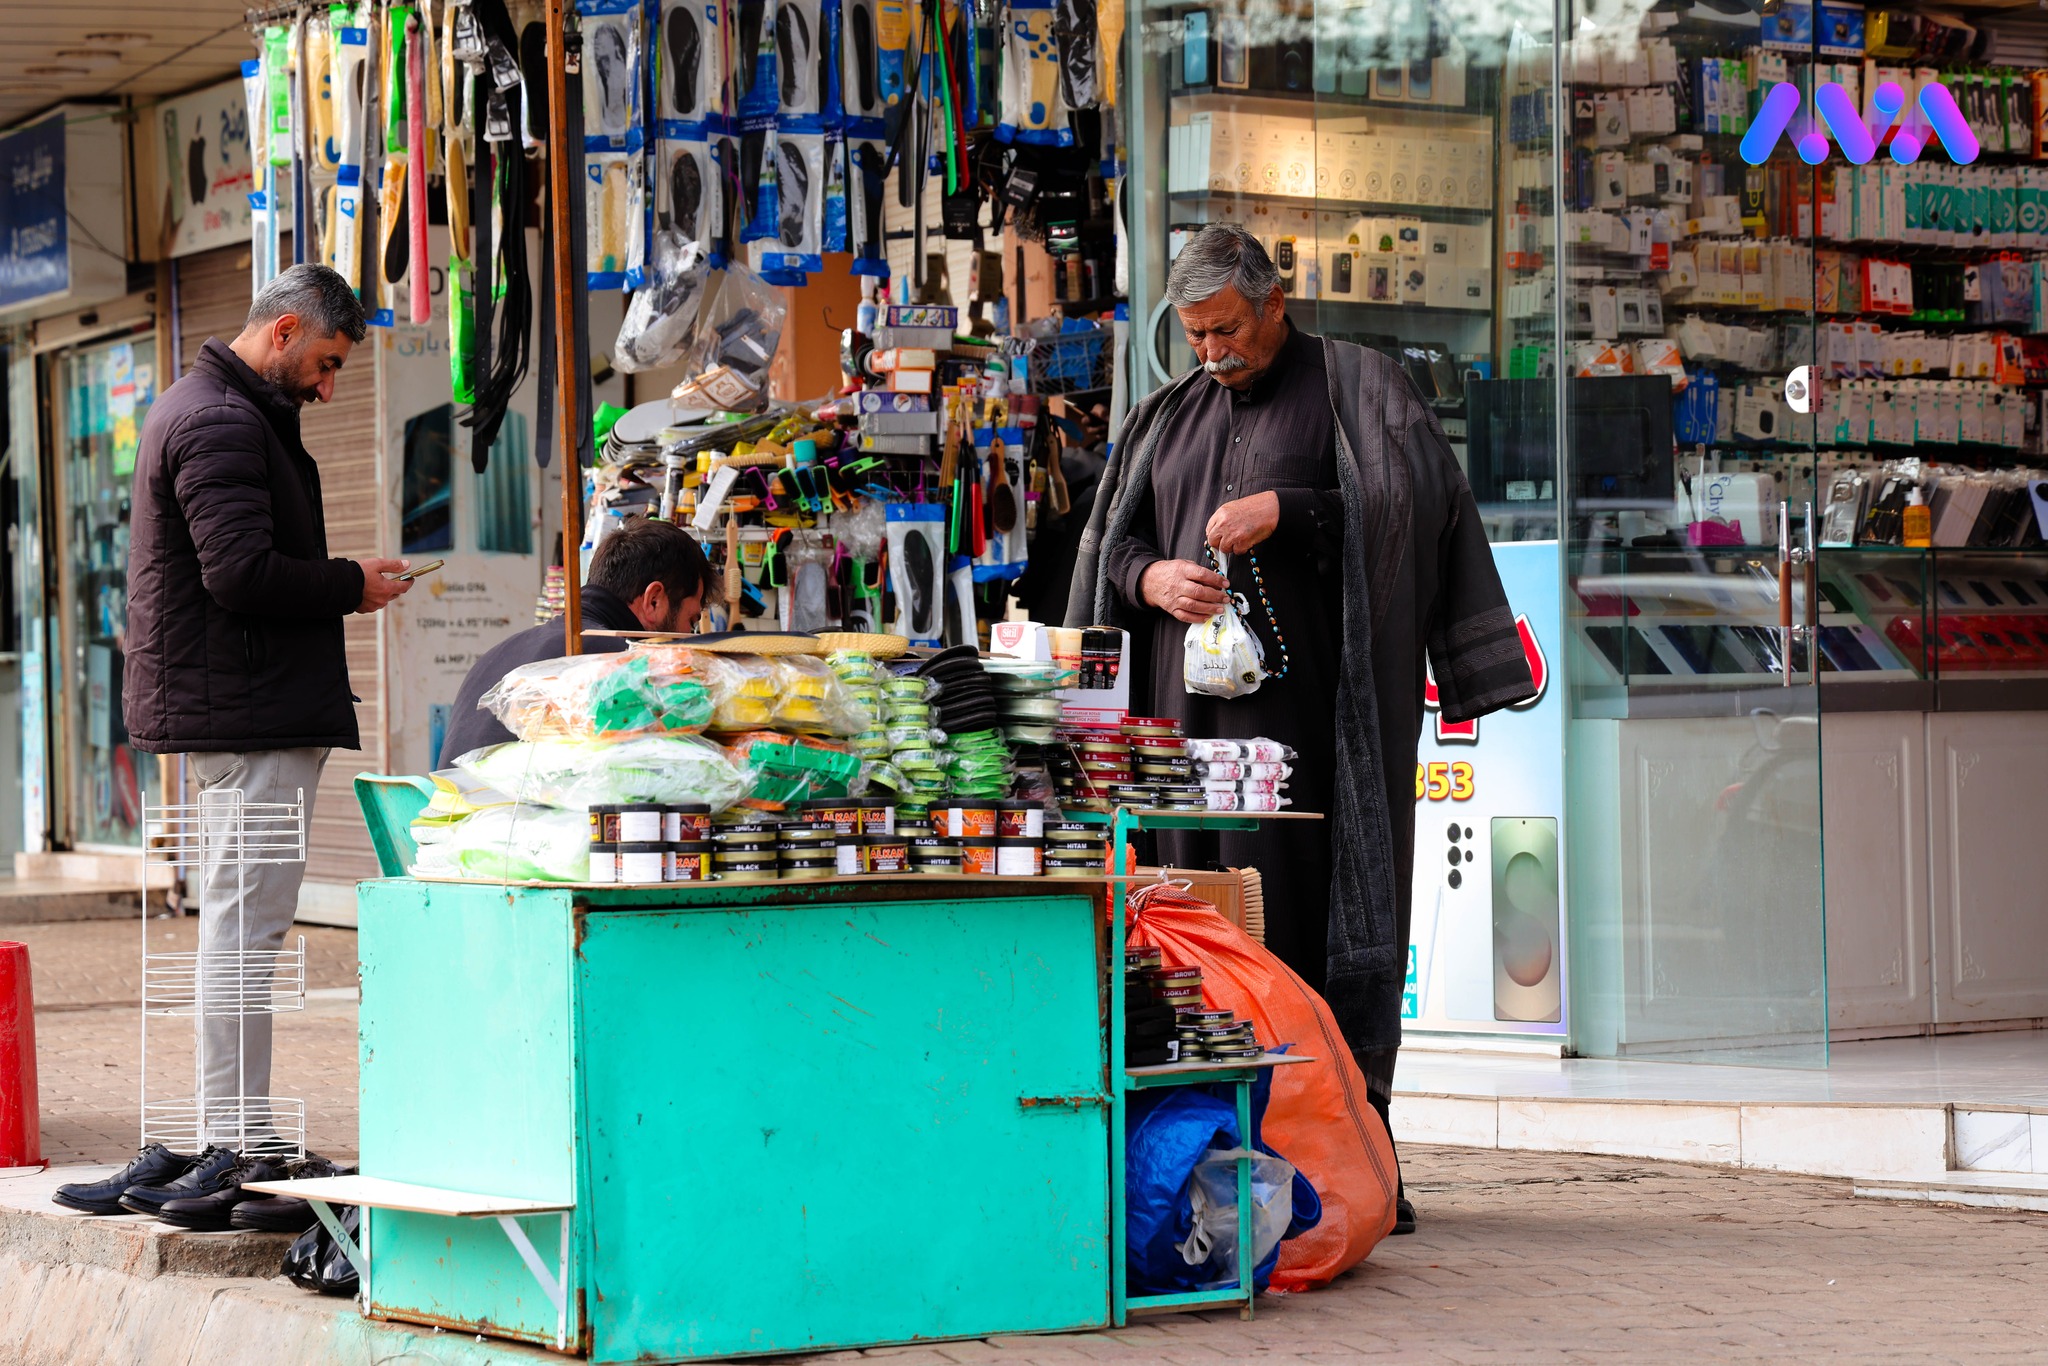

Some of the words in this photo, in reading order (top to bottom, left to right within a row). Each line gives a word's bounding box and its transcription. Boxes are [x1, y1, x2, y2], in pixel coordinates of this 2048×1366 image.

[822, 812, 858, 822] ALKAN
[861, 812, 886, 822] ALKA
[870, 848, 905, 859] ALKAN
